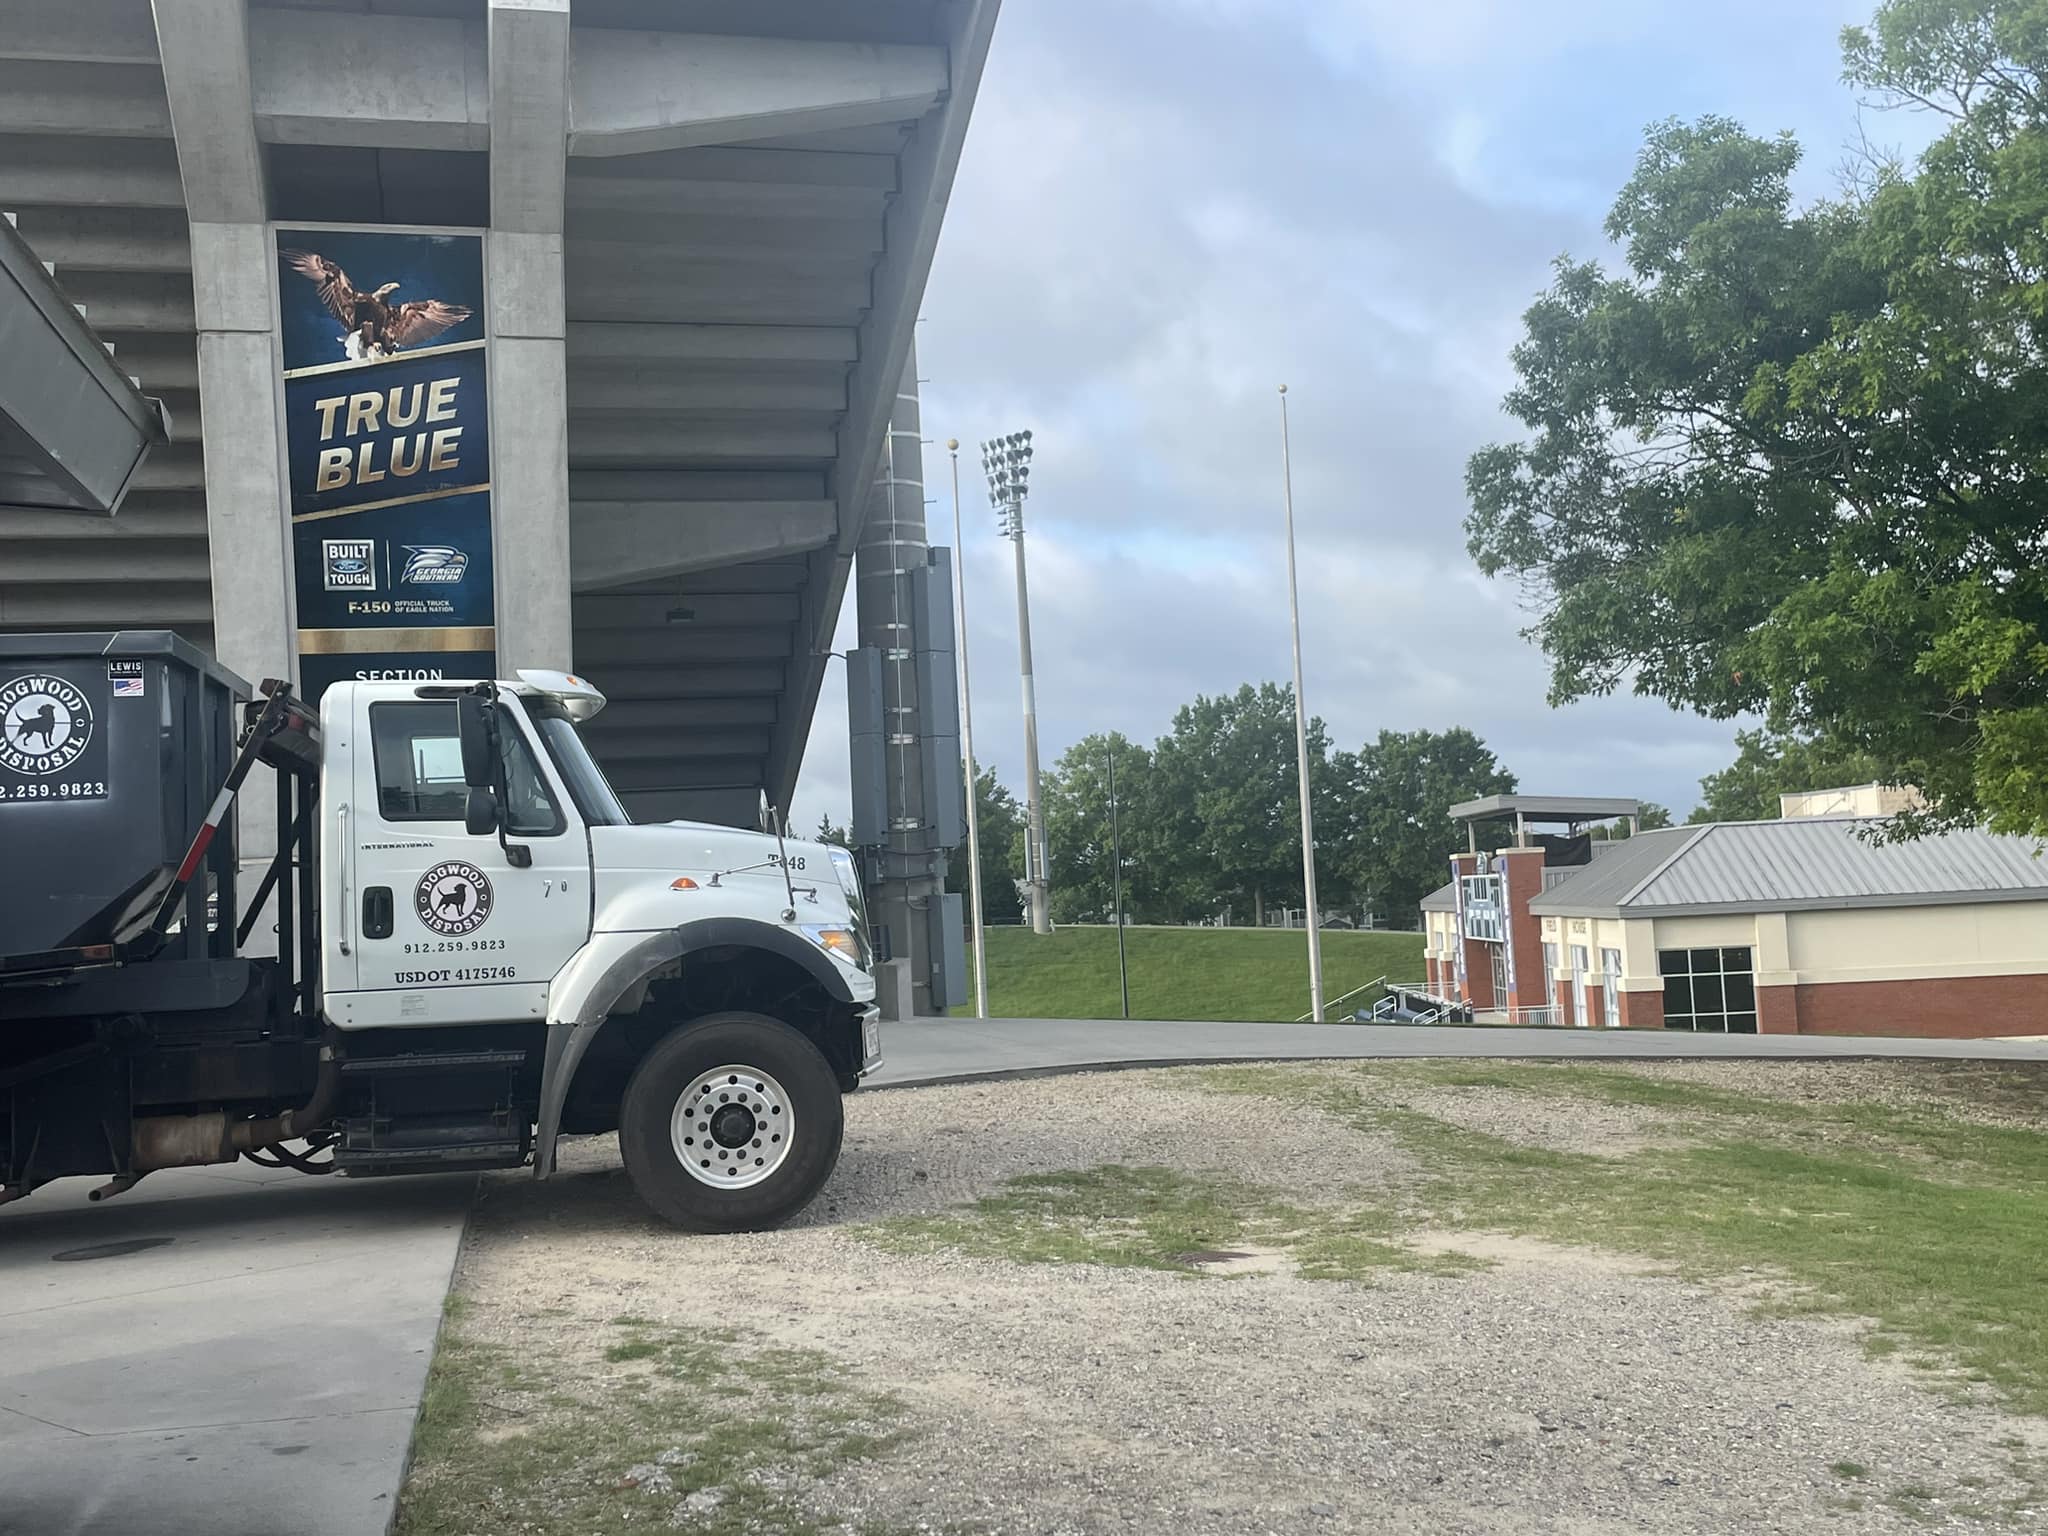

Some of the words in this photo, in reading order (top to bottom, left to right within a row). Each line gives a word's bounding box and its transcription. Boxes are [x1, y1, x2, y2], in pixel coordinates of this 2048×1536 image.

[315, 377, 461, 441] TRUE
[316, 426, 464, 492] BLUE
[329, 545, 368, 559] BUILT
[330, 573, 370, 585] TOUGH
[348, 601, 391, 613] F-150
[110, 662, 142, 671] LEWIS
[421, 865, 485, 892] DOGWOOD
[421, 908, 487, 933] DISPOSAL
[404, 940, 506, 954] 912.259.9823
[394, 970, 451, 983] USDOT
[455, 966, 516, 980] 4175746
